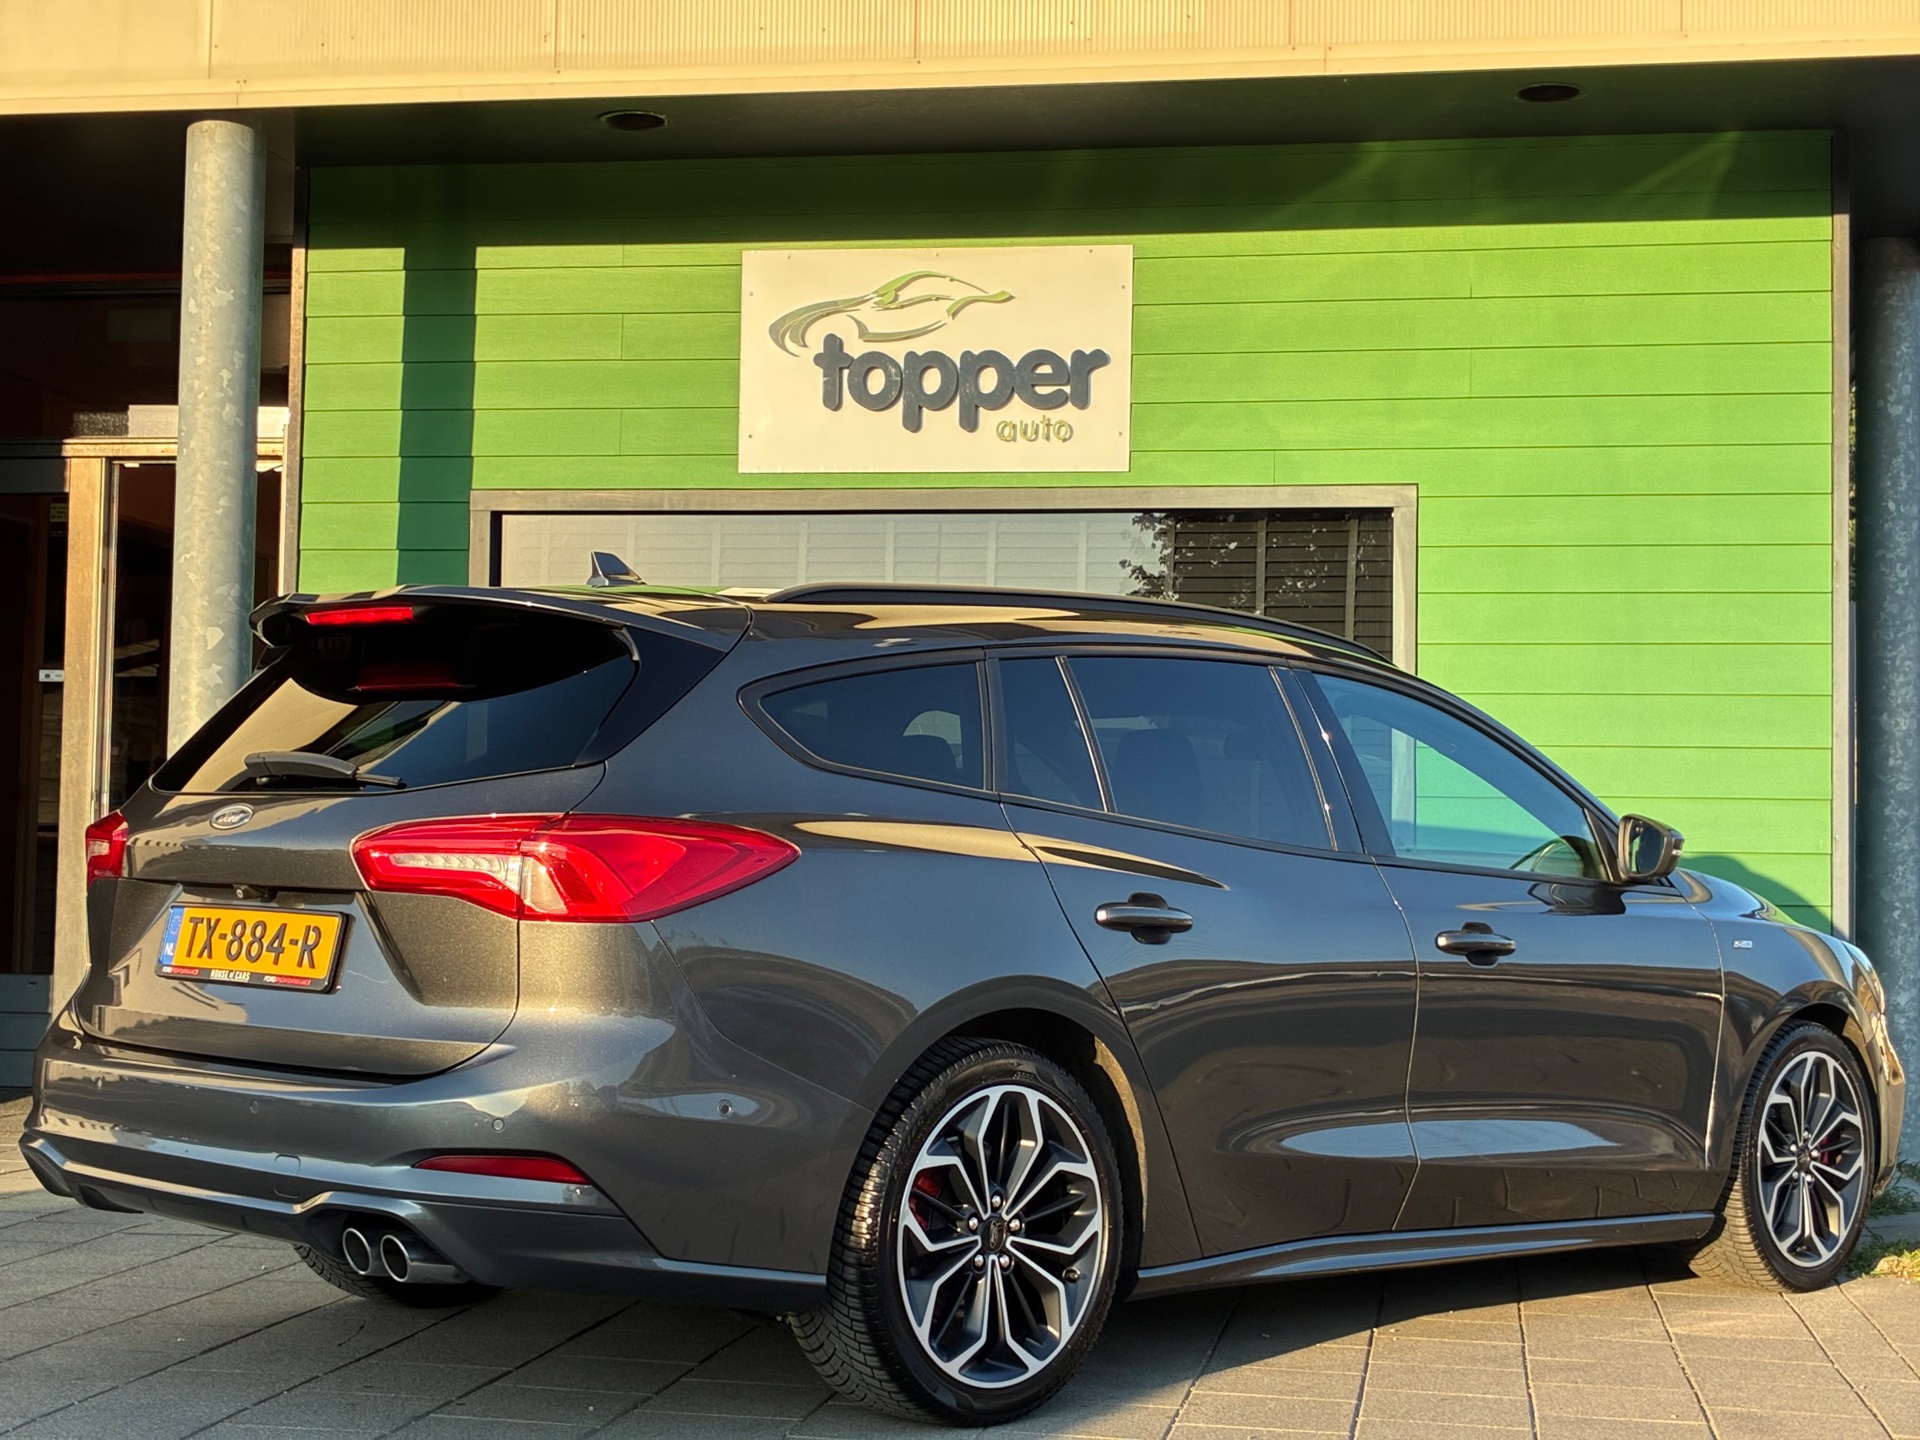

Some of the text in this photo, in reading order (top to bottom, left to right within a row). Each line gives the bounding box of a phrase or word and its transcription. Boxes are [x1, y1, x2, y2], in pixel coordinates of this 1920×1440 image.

[813, 333, 1111, 432] topper
[996, 415, 1073, 442] auto
[164, 943, 174, 956] NL
[186, 917, 322, 969] TX-884-R
[210, 969, 229, 980] HOUSE
[235, 971, 250, 981] CARS
